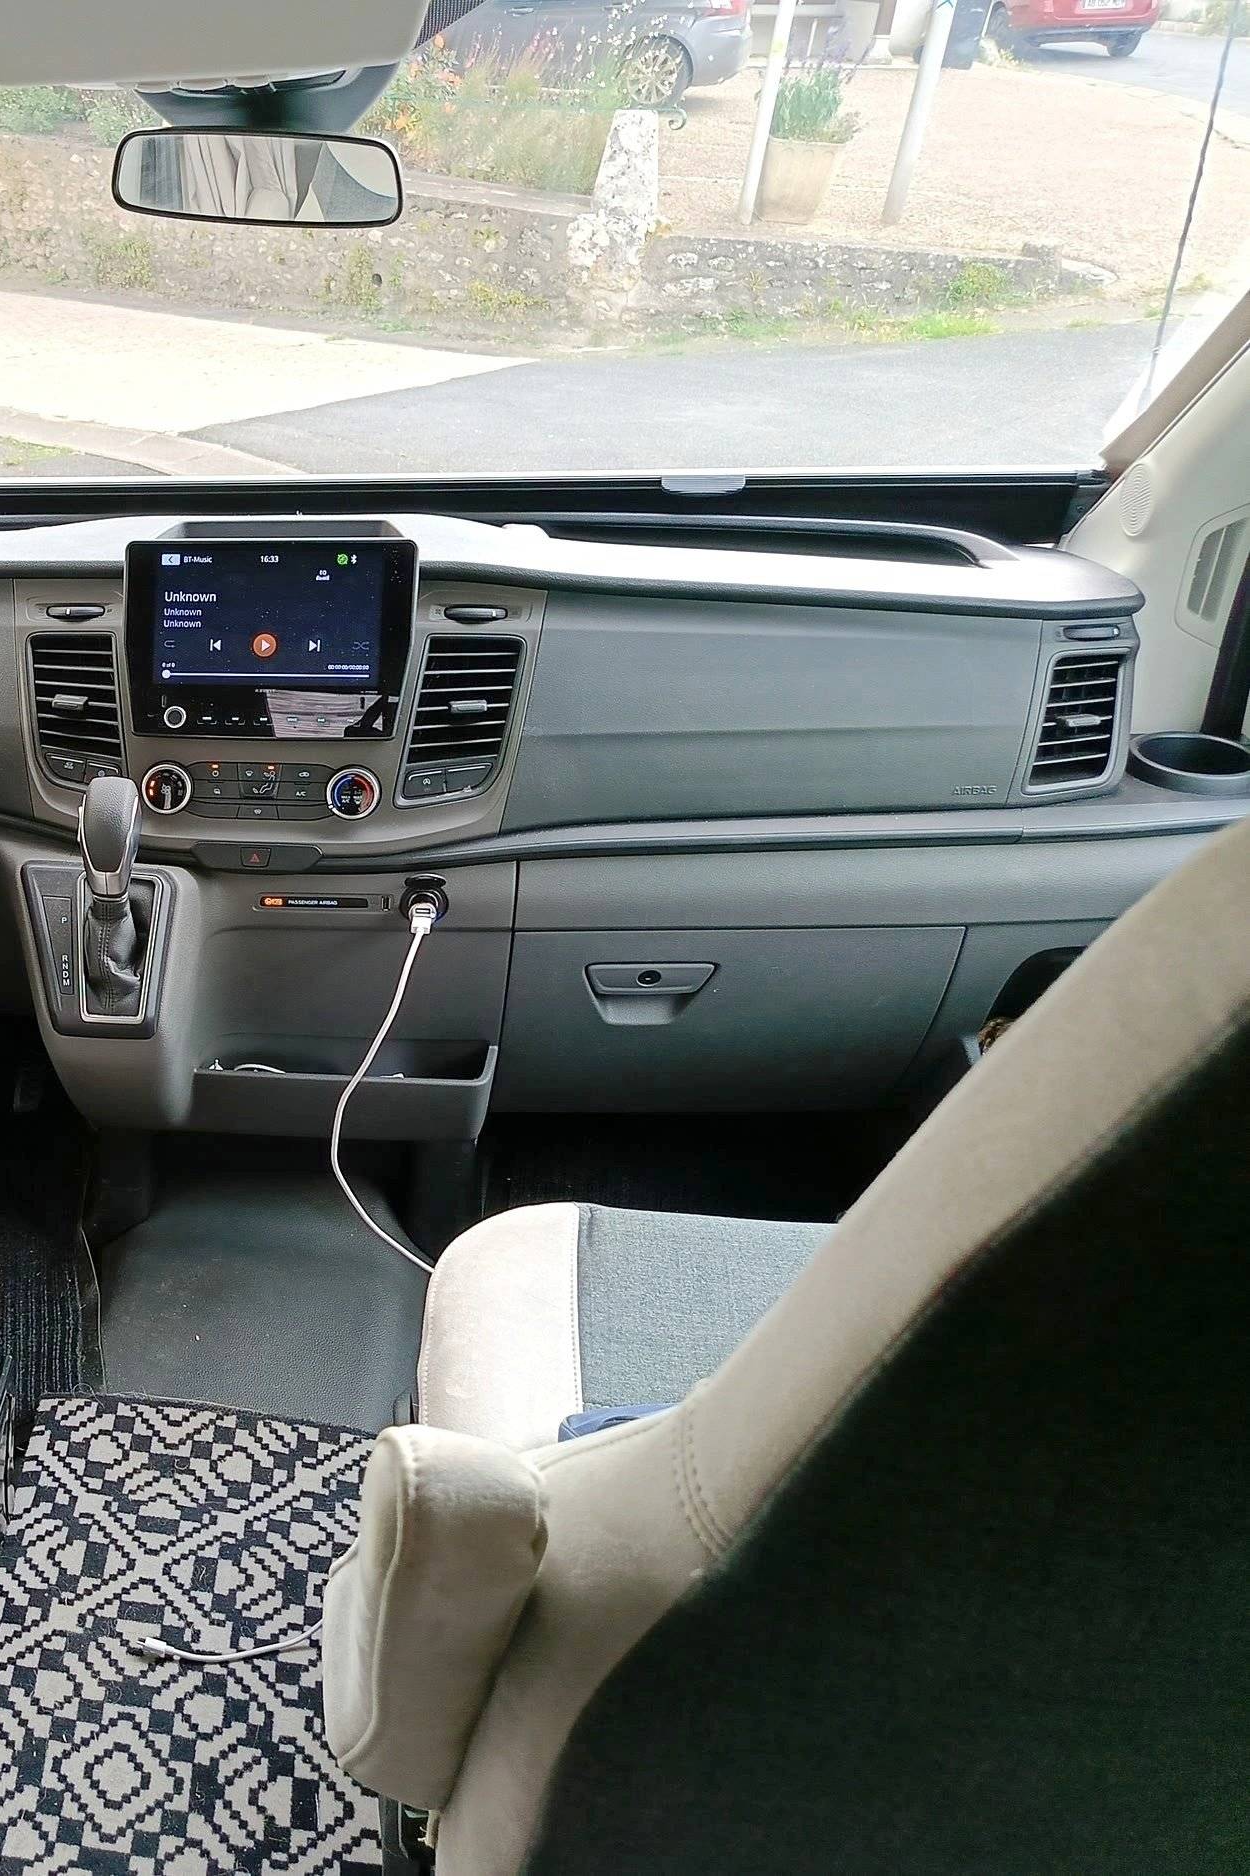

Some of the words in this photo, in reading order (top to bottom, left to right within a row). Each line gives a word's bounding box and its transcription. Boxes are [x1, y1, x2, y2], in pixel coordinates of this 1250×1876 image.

[183, 555, 213, 563] BT-Music
[260, 555, 279, 563] 16:33
[164, 591, 217, 603] Unknown
[163, 608, 202, 616] Unknown
[163, 620, 202, 628] Unknown
[952, 785, 998, 796] AIRBAG
[61, 916, 68, 924] P
[62, 954, 69, 962] R
[62, 978, 70, 986] M
